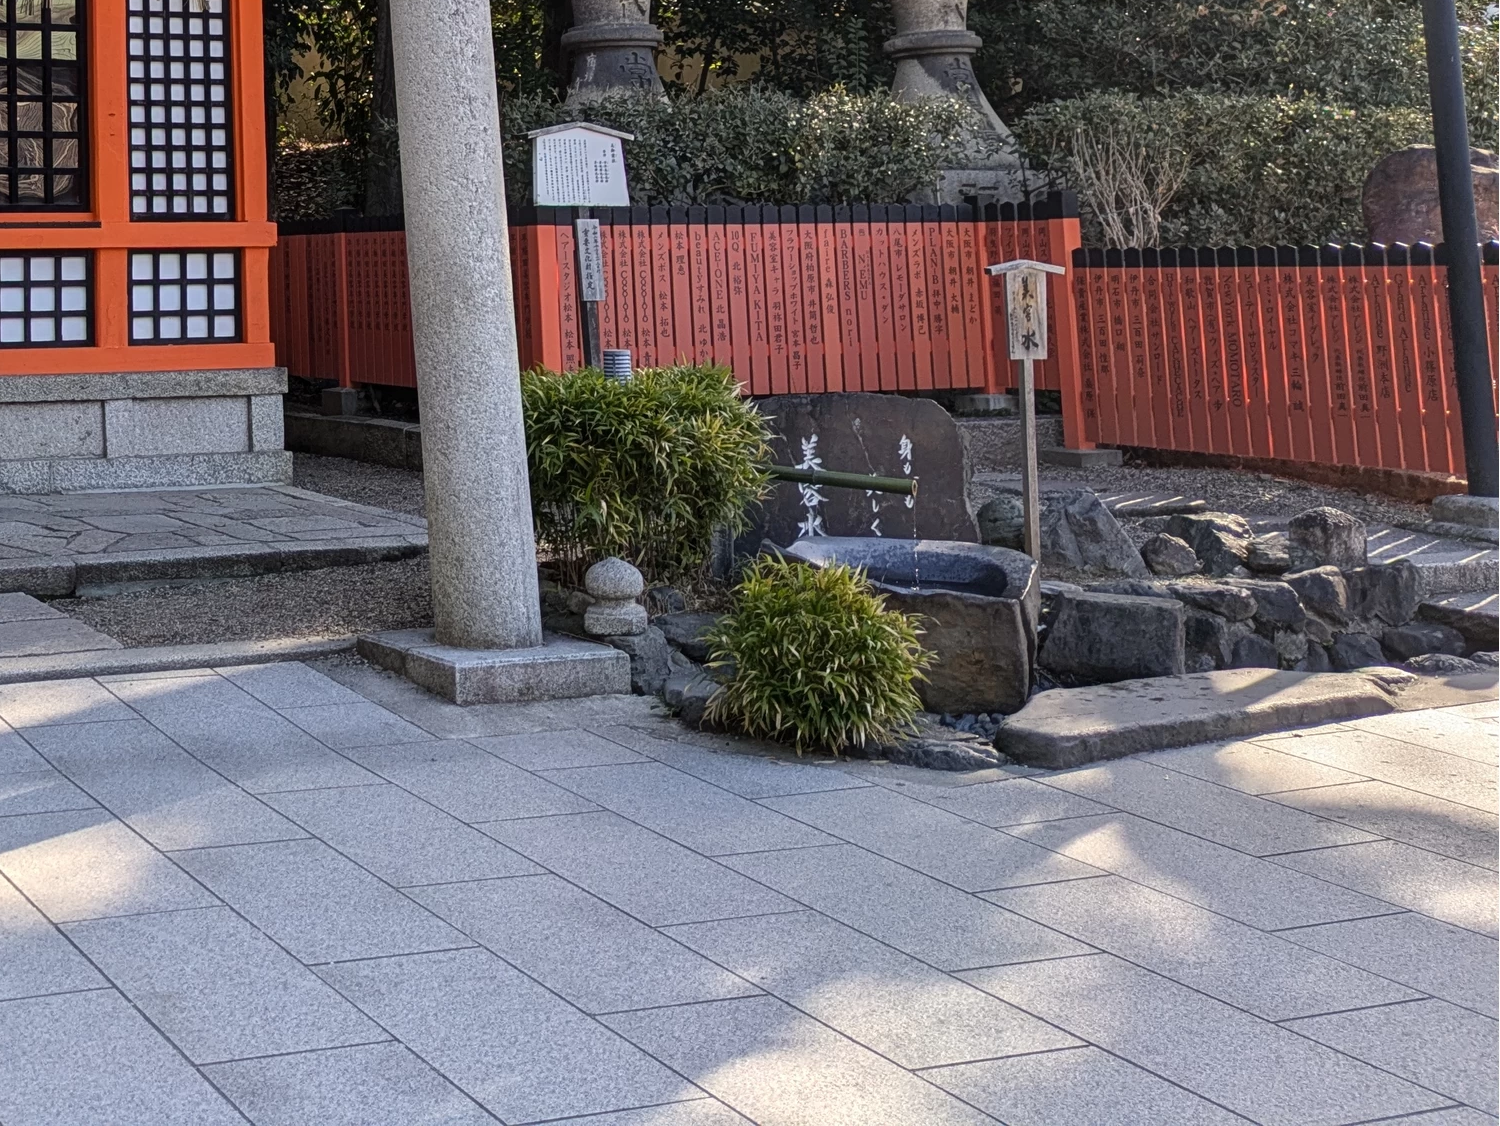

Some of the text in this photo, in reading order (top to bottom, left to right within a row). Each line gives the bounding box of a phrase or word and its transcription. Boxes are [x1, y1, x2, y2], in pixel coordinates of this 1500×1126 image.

[581, 228, 595, 291] 重要文化財指定
[618, 230, 628, 267] 株式会社
[637, 230, 647, 267] 株式会社
[657, 232, 667, 282] メンズボス
[675, 231, 684, 251] 松本
[840, 229, 851, 301] BARBERS
[893, 229, 903, 258] 八尾市
[911, 229, 922, 279] メンズラボ
[928, 227, 939, 284] PLAN-B
[946, 227, 955, 260] 大阪市
[659, 291, 668, 312] 松本
[750, 232, 763, 342] FUMIYA KITA
[876, 228, 889, 324] カットハウス・ダン
[963, 227, 973, 260] 大阪市
[968, 292, 978, 324] まどか
[1129, 273, 1140, 308] 伊丹市
[1370, 274, 1384, 339] Arrange
[1394, 273, 1412, 393] Grand Arrange
[1417, 274, 1431, 340] Arrange
[641, 327, 651, 349] 松本
[699, 338, 709, 364] ゆか
[1227, 331, 1243, 408] MOMOTARO
[897, 434, 920, 509] 身もも
[866, 472, 883, 536] しく
